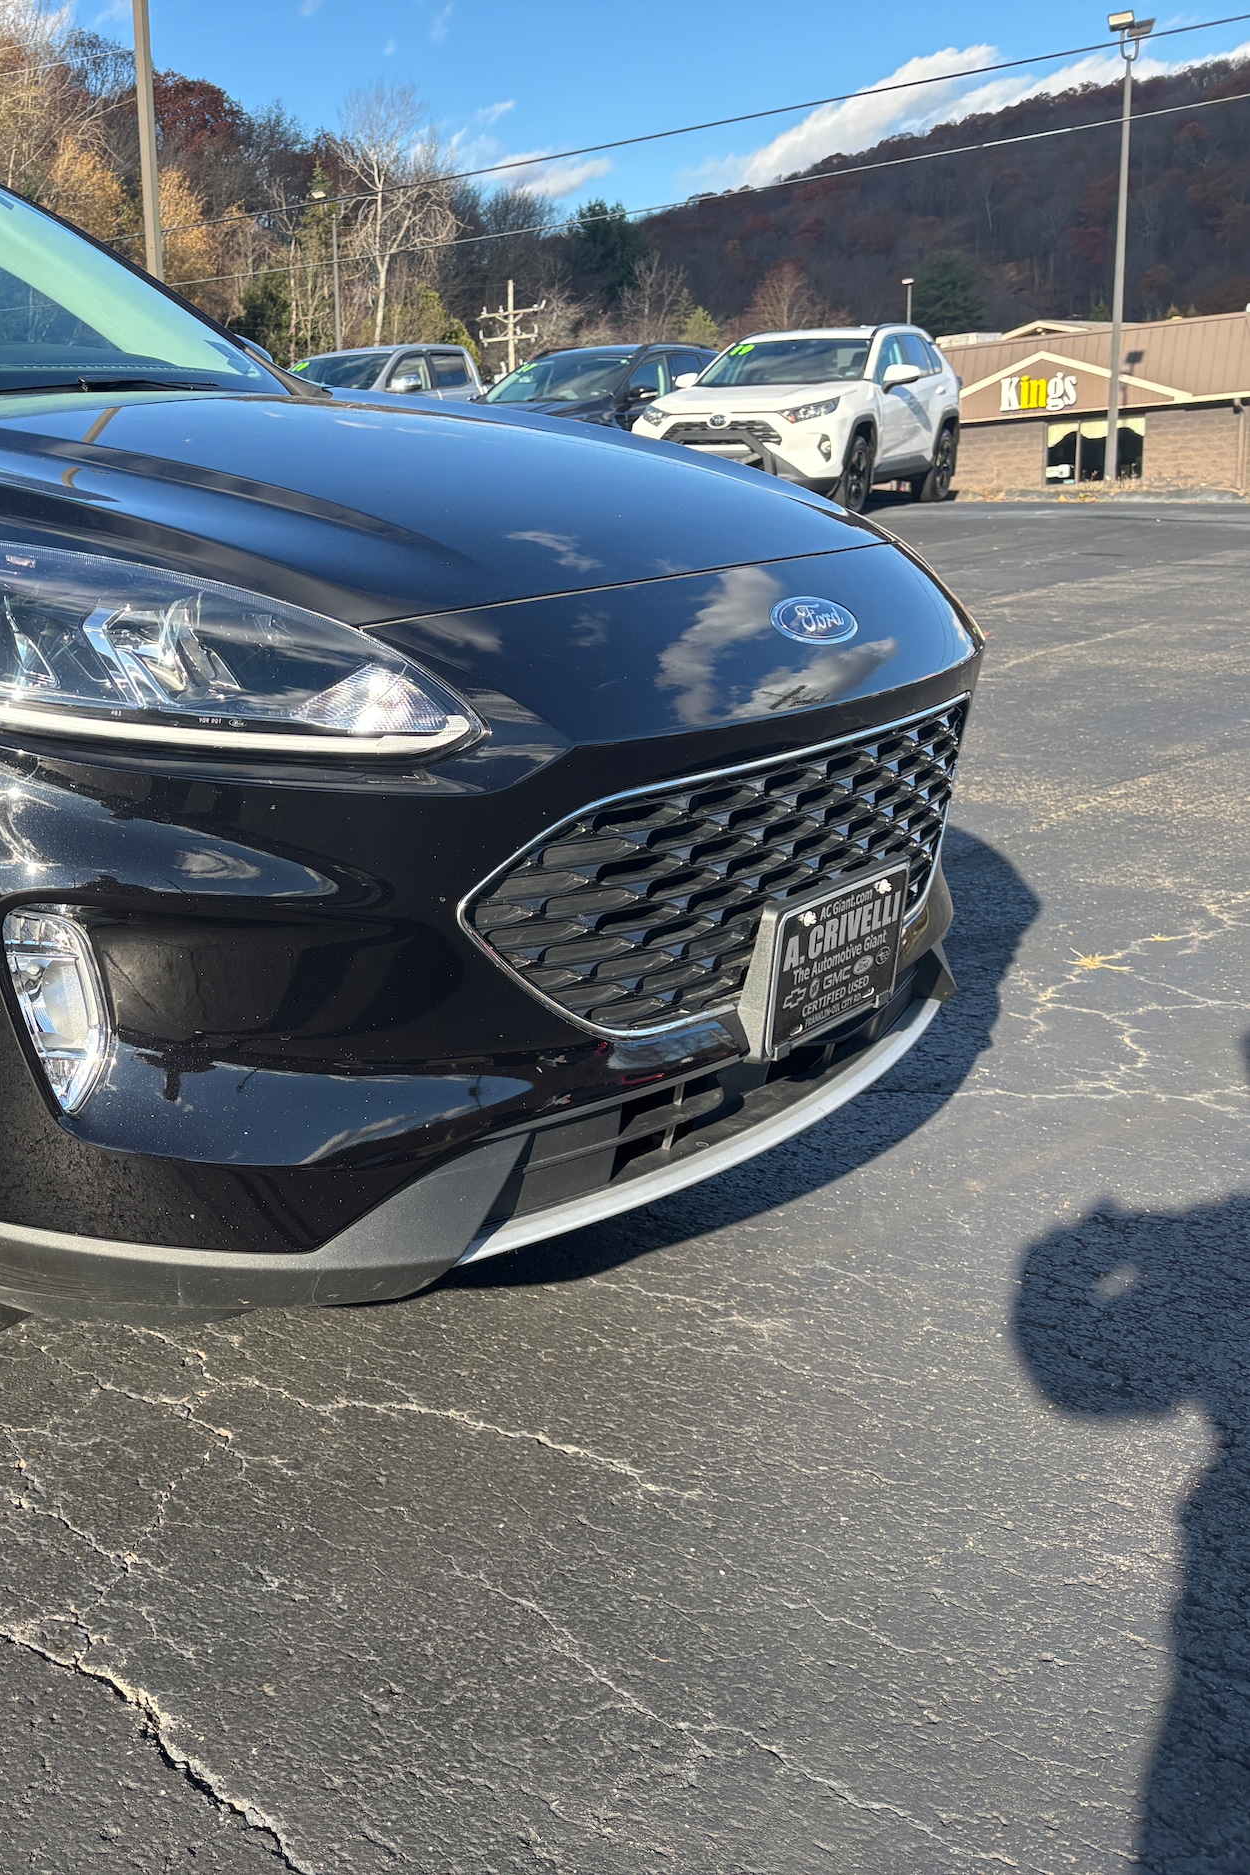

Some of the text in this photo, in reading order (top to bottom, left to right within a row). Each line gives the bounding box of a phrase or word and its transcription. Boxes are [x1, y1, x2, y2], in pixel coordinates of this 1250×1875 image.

[999, 372, 1077, 411] Kings
[795, 603, 845, 632] Ford
[783, 891, 901, 972] A. CRIVELLI
[793, 929, 887, 986] The Automotive Giant
[823, 965, 852, 990] GMC
[802, 975, 869, 1017] CERTIFIED USED
